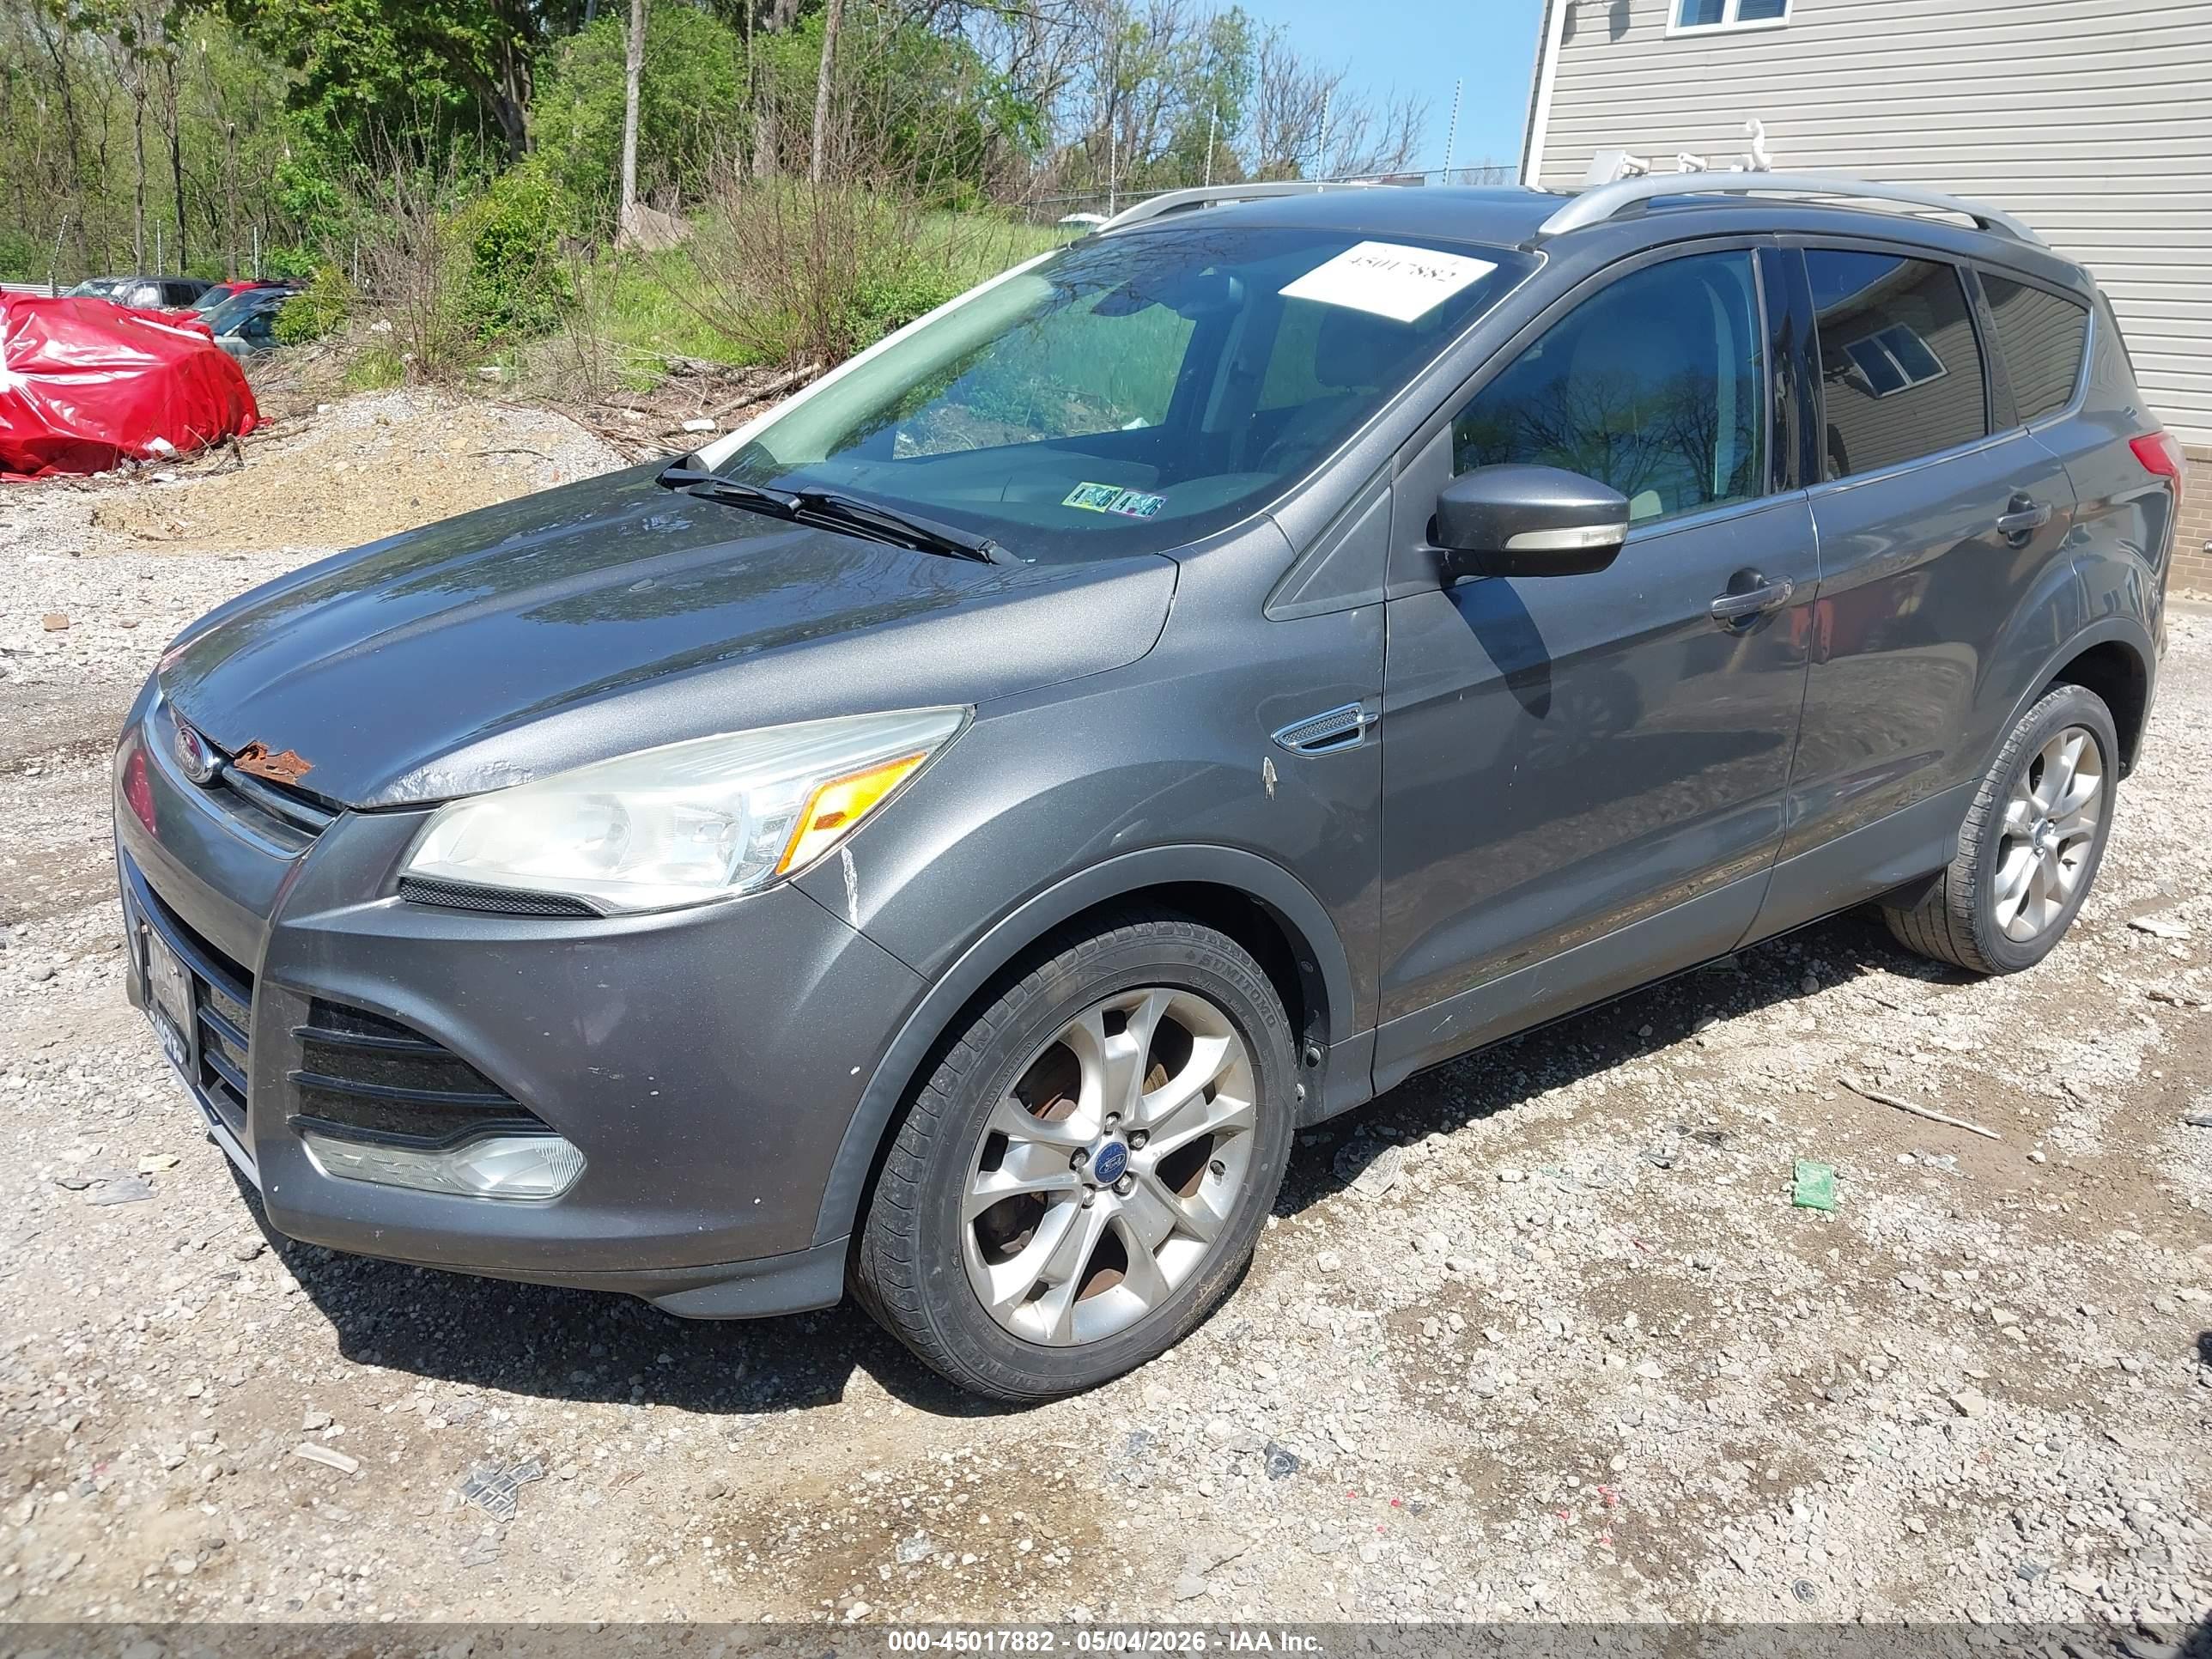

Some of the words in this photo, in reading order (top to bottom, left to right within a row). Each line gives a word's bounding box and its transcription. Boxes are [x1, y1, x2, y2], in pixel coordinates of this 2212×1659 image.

[1072, 489, 1086, 502] 4
[1119, 495, 1133, 510] 4
[1198, 954, 1276, 1028] SUMITOMO
